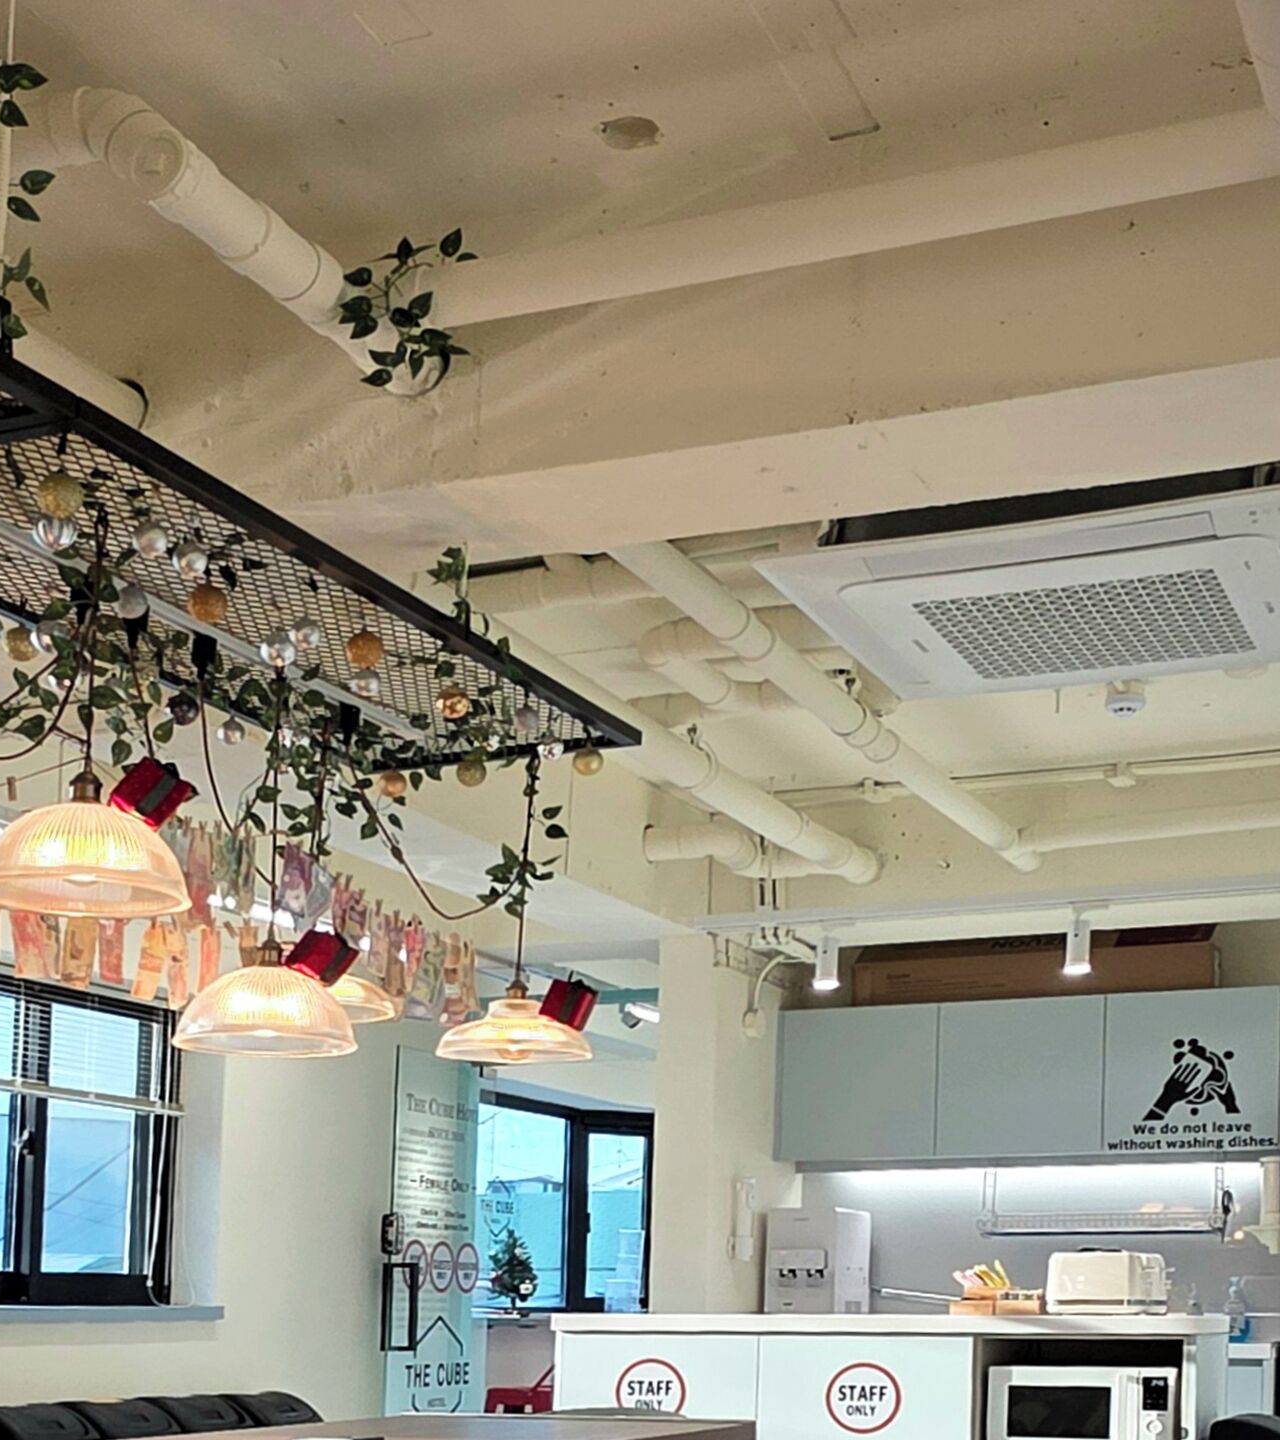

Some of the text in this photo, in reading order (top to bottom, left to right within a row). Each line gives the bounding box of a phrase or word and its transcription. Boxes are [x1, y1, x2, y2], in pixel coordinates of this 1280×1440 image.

[1133, 1122, 1252, 1135] We do not leave
[1107, 1136, 1280, 1150] without washing dishes.
[405, 1362, 470, 1388] THE CUBE
[627, 1380, 674, 1396] STAFF
[838, 1385, 888, 1402] STAFF
[846, 1404, 876, 1416] ONLY
